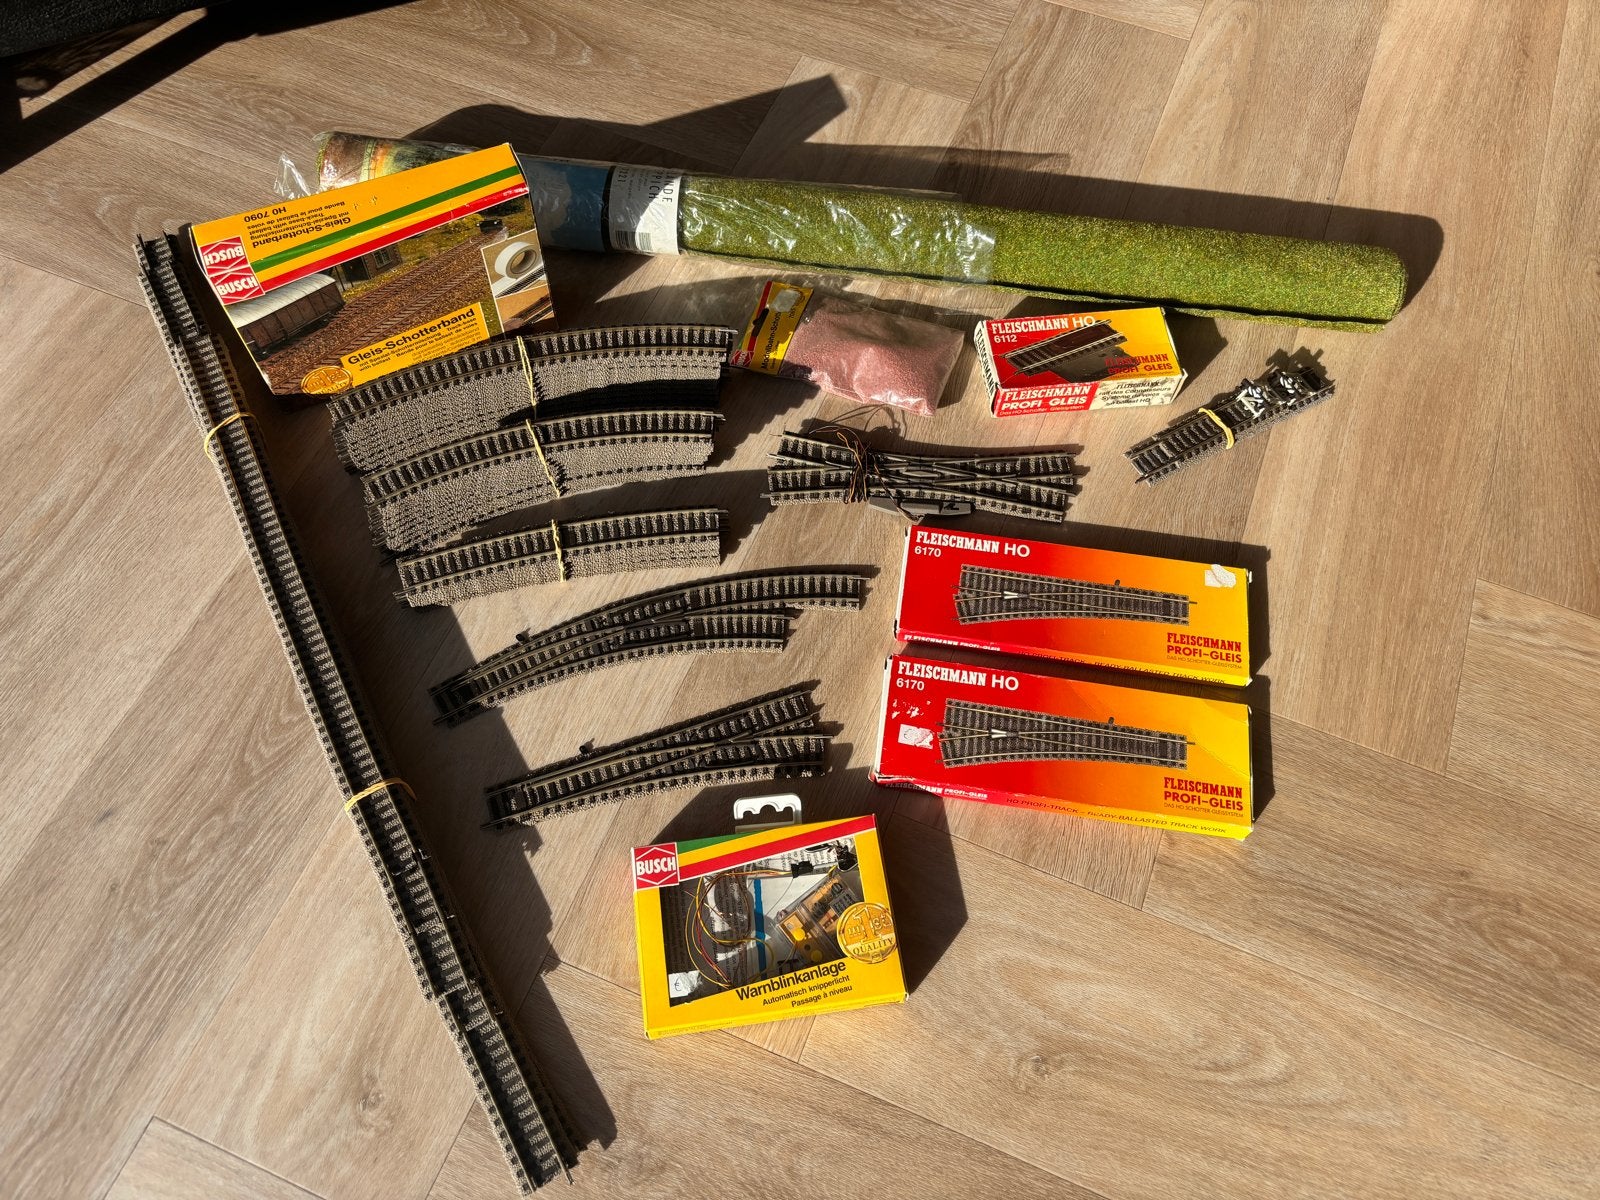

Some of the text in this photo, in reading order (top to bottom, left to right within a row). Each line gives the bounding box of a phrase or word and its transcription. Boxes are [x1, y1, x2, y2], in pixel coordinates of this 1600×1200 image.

[308, 205, 324, 214] pour
[324, 201, 346, 210] Bande
[244, 211, 270, 223] 7090
[248, 221, 266, 230] voies
[249, 213, 325, 236] Track-base with ballast
[267, 217, 275, 225] de
[277, 212, 299, 223] ballast
[252, 217, 351, 248] Gleis-Schotterband
[204, 245, 245, 266] BUSCH
[216, 276, 259, 296] BUSCH
[991, 318, 1069, 334] FLEISCHMANN
[348, 308, 475, 365] Gleis-Schotterband
[993, 334, 1018, 343] 6112
[976, 328, 994, 396] FLEISCHMANN
[1105, 353, 1168, 366] FLEISCHMANN
[1108, 365, 1139, 375] PROFI
[1144, 362, 1173, 372] GLEIS
[1005, 385, 1092, 401] FLEISCHMANN
[1001, 396, 1088, 411] PROFI GLEIS
[916, 531, 1000, 553] FLEISCHMANN
[914, 545, 942, 558] 6170
[904, 634, 1001, 651] FLEISCHMANN PROFI-GLEIS
[1167, 632, 1241, 652] FLEISCHMANN
[1167, 645, 1242, 663] PROFI-GLEIS
[898, 661, 987, 686] FLEISCHMANN
[896, 678, 925, 691] 6170
[886, 782, 988, 799] FLEISCHMANN PROFI-GLEIS
[1163, 776, 1243, 799] FLEISCHMANN
[1164, 791, 1244, 811] PROFI-GLEIS
[1021, 800, 1079, 814] PROFI-TRACK
[1087, 811, 1168, 825] READY-BALLASTED
[1170, 821, 1199, 830] TRACK
[1200, 825, 1226, 834] WORK
[636, 855, 677, 875] BUSCH
[853, 938, 895, 956] QUALITY
[735, 961, 846, 1001] Warnblinkanlage
[763, 975, 850, 1006] Automatisch knipperlicht
[791, 994, 822, 1008] Passage
[829, 985, 853, 997] niveau
